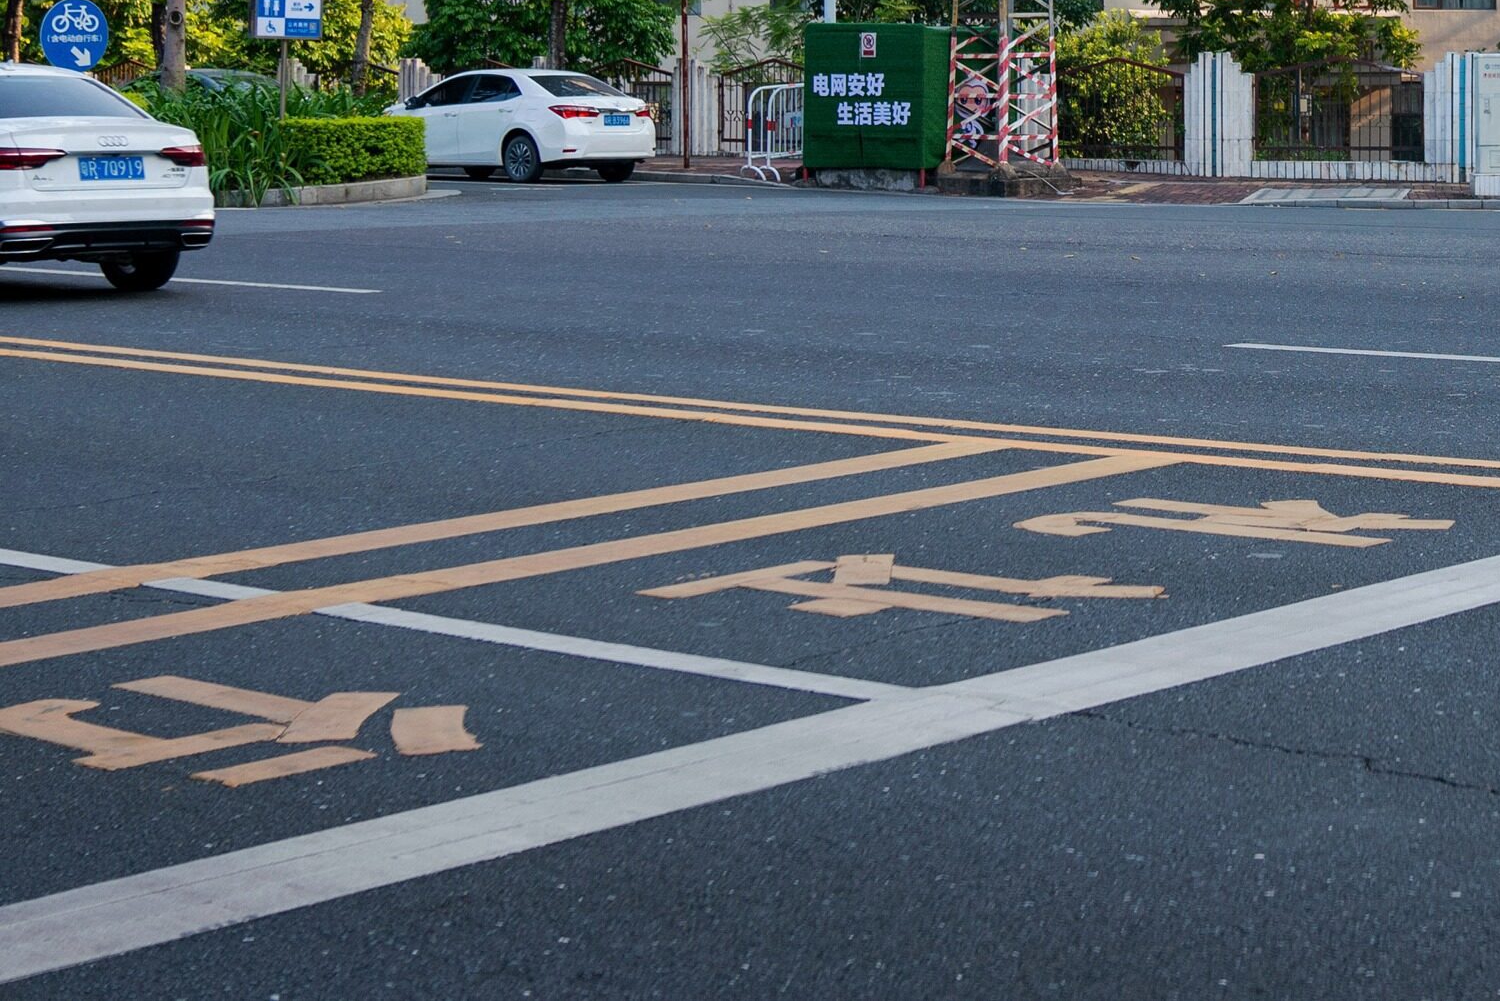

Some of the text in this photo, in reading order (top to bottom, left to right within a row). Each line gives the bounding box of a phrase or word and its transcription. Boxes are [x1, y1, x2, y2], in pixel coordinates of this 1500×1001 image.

[813, 73, 885, 97] 电网安好
[837, 101, 911, 126] 生活美好
